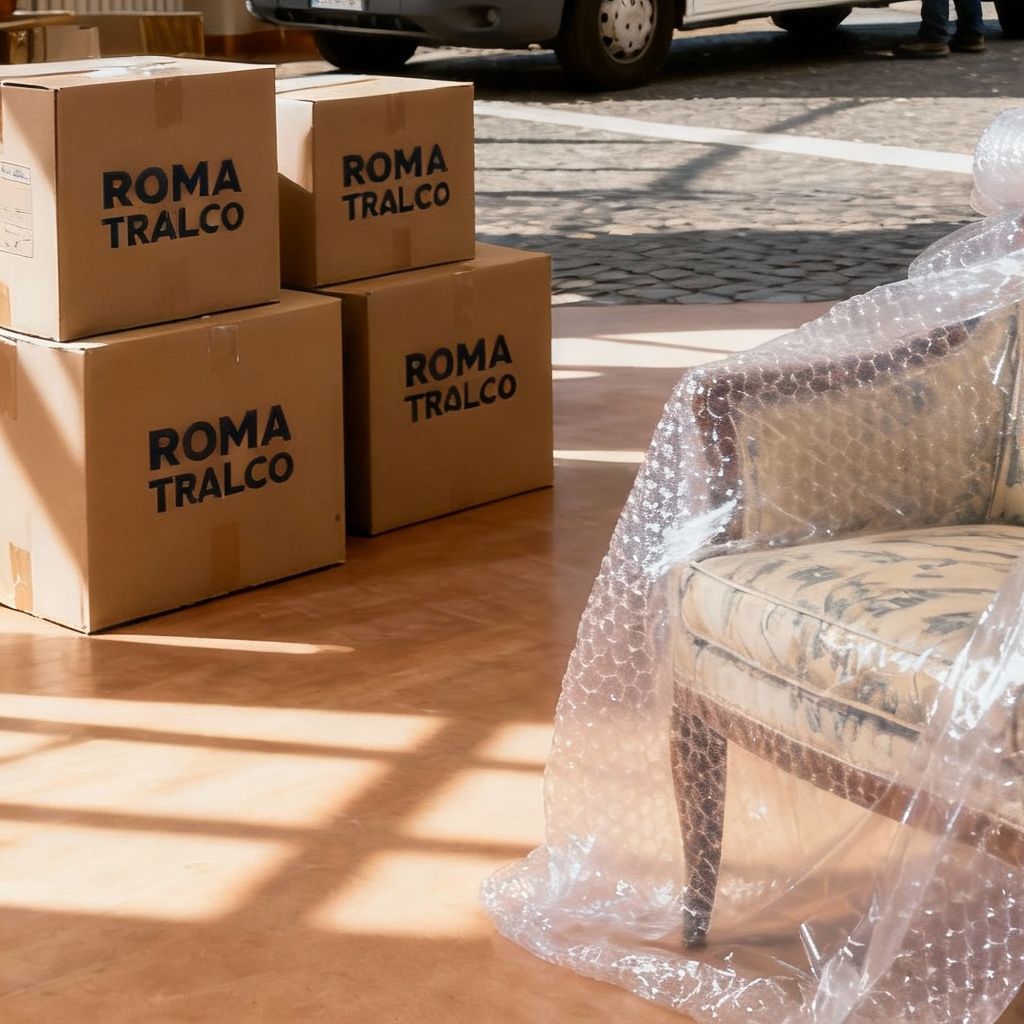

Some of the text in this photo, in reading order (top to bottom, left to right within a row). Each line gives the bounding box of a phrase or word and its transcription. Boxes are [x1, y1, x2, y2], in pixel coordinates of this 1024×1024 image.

[102, 159, 242, 209] ROMA
[342, 144, 449, 187] ROMA
[102, 201, 245, 250] TRALCO
[342, 181, 450, 221] TRALCO
[405, 334, 513, 389] ROMA
[404, 374, 517, 424] TRALCO
[148, 404, 292, 471] ROMA
[148, 451, 294, 514] TRALCO
